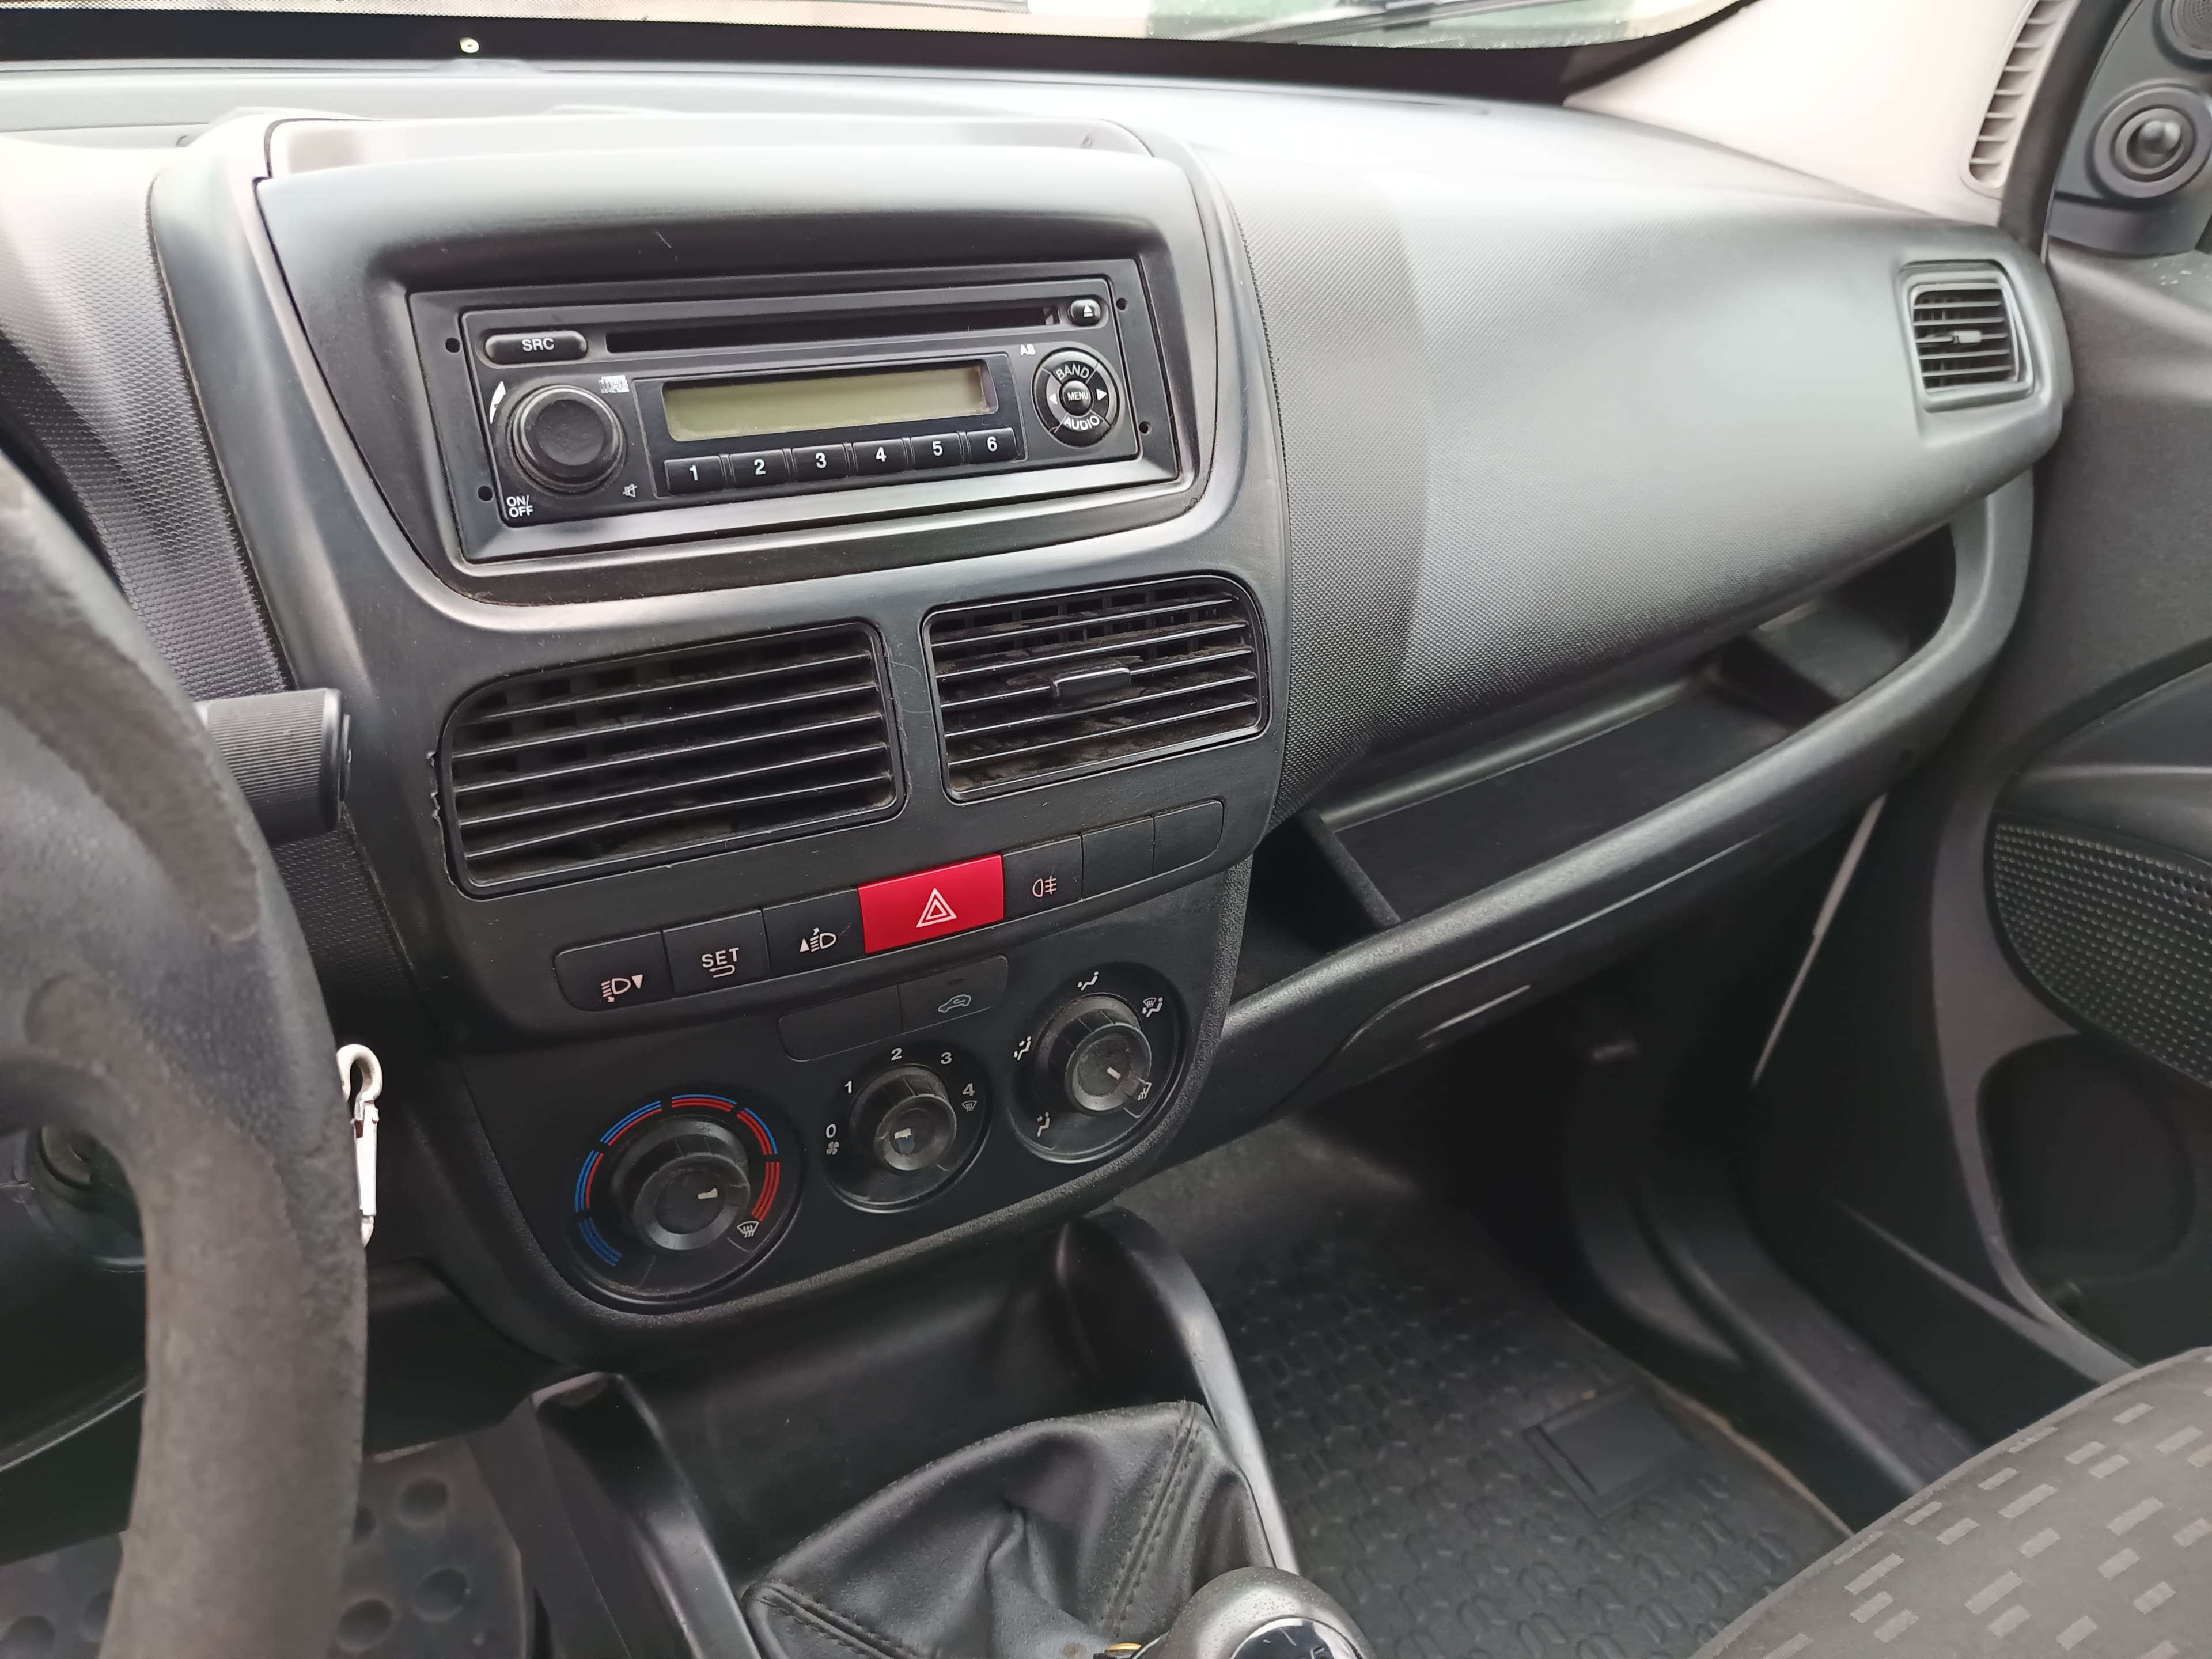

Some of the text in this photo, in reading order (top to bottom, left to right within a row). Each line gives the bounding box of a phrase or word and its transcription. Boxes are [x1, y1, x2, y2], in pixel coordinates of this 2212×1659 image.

[522, 337, 555, 352] SRC
[1020, 344, 1036, 356] AS
[1055, 363, 1089, 381] BAND
[1067, 391, 1089, 402] MENU
[1063, 415, 1100, 431] AUDIO
[689, 436, 997, 481] 1 2 3 4 5 6
[506, 495, 529, 507] ON/
[509, 505, 533, 517] OFF
[702, 948, 739, 968] SET
[891, 1048, 952, 1065] 2 3
[844, 1081, 853, 1093] 1
[963, 1083, 975, 1096] 4
[825, 1124, 836, 1138] 0
